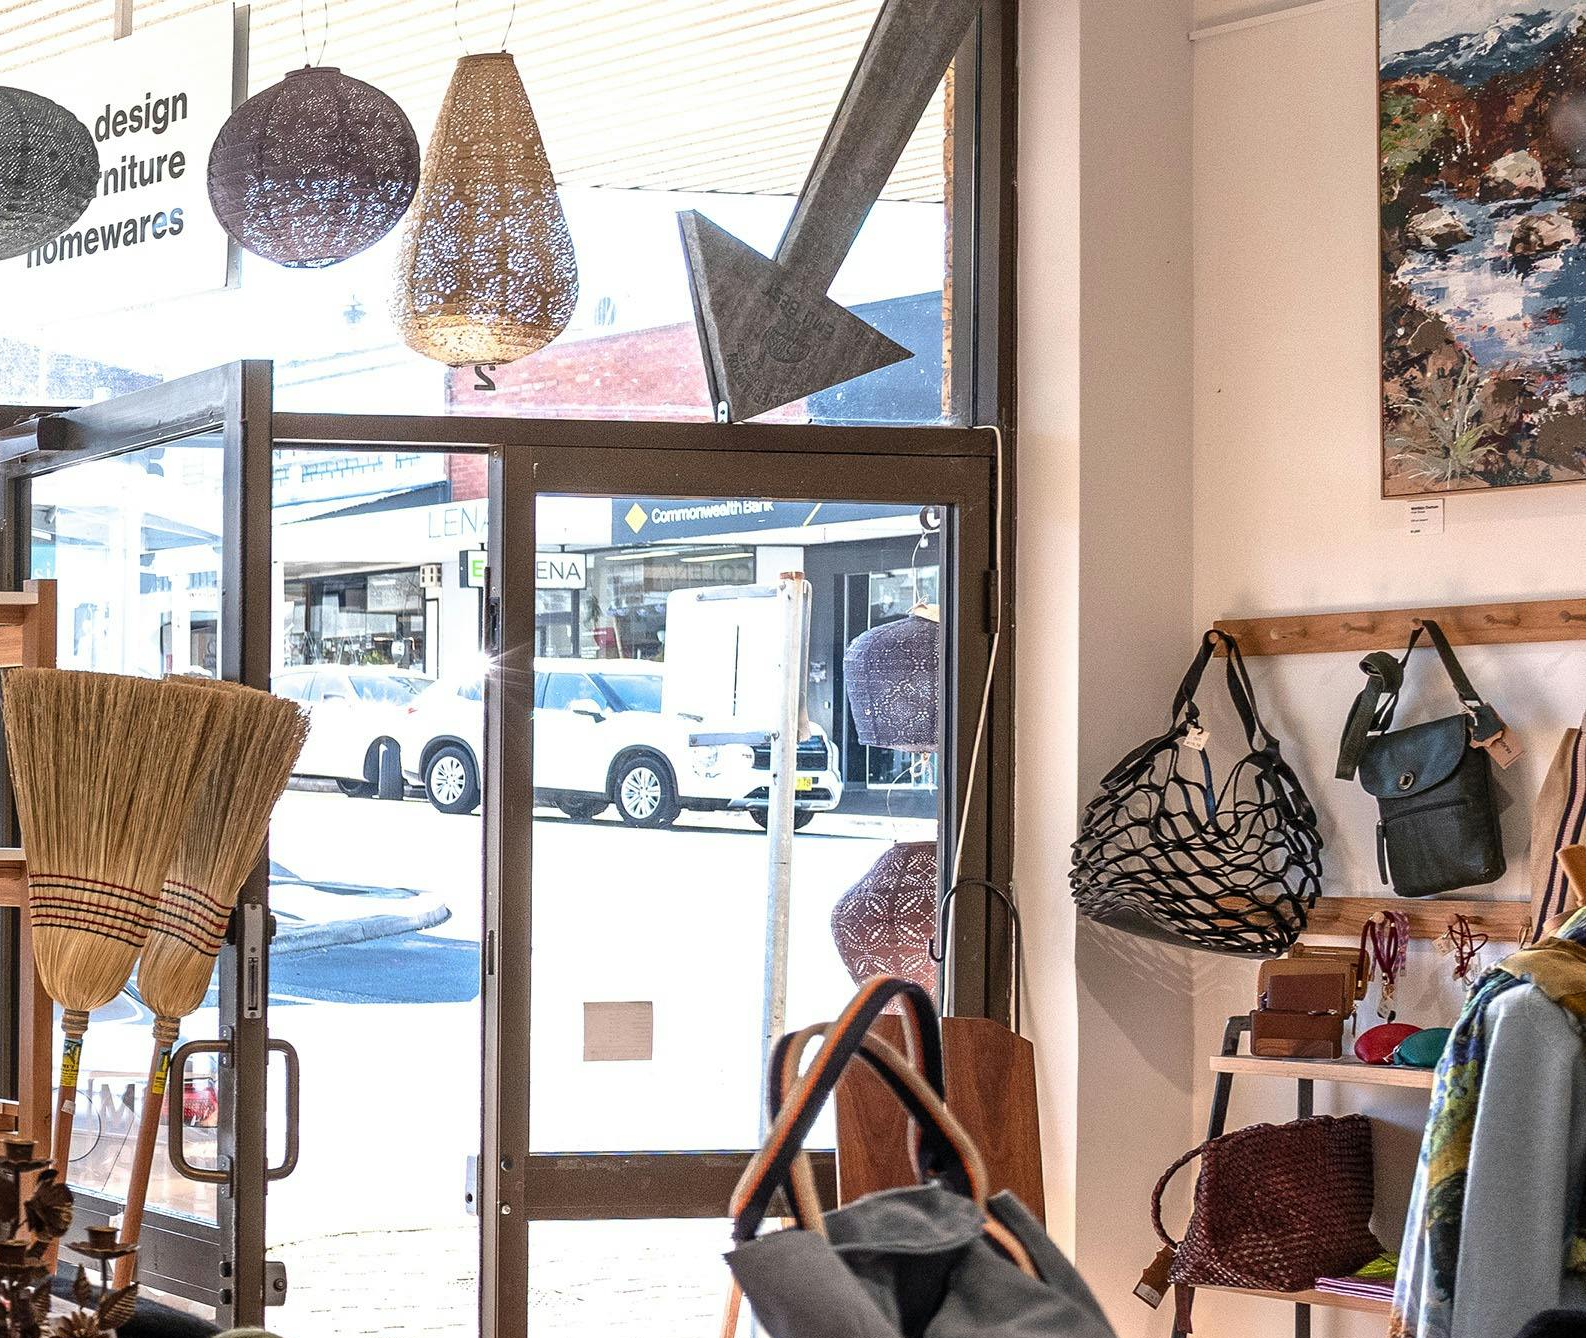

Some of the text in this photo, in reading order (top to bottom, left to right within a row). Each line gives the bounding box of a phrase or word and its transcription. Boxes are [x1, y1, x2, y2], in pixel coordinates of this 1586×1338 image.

[94, 91, 188, 142] design
[94, 149, 186, 199] rniture
[651, 500, 774, 524] Commonwealth Bank
[537, 561, 581, 580] ENA
